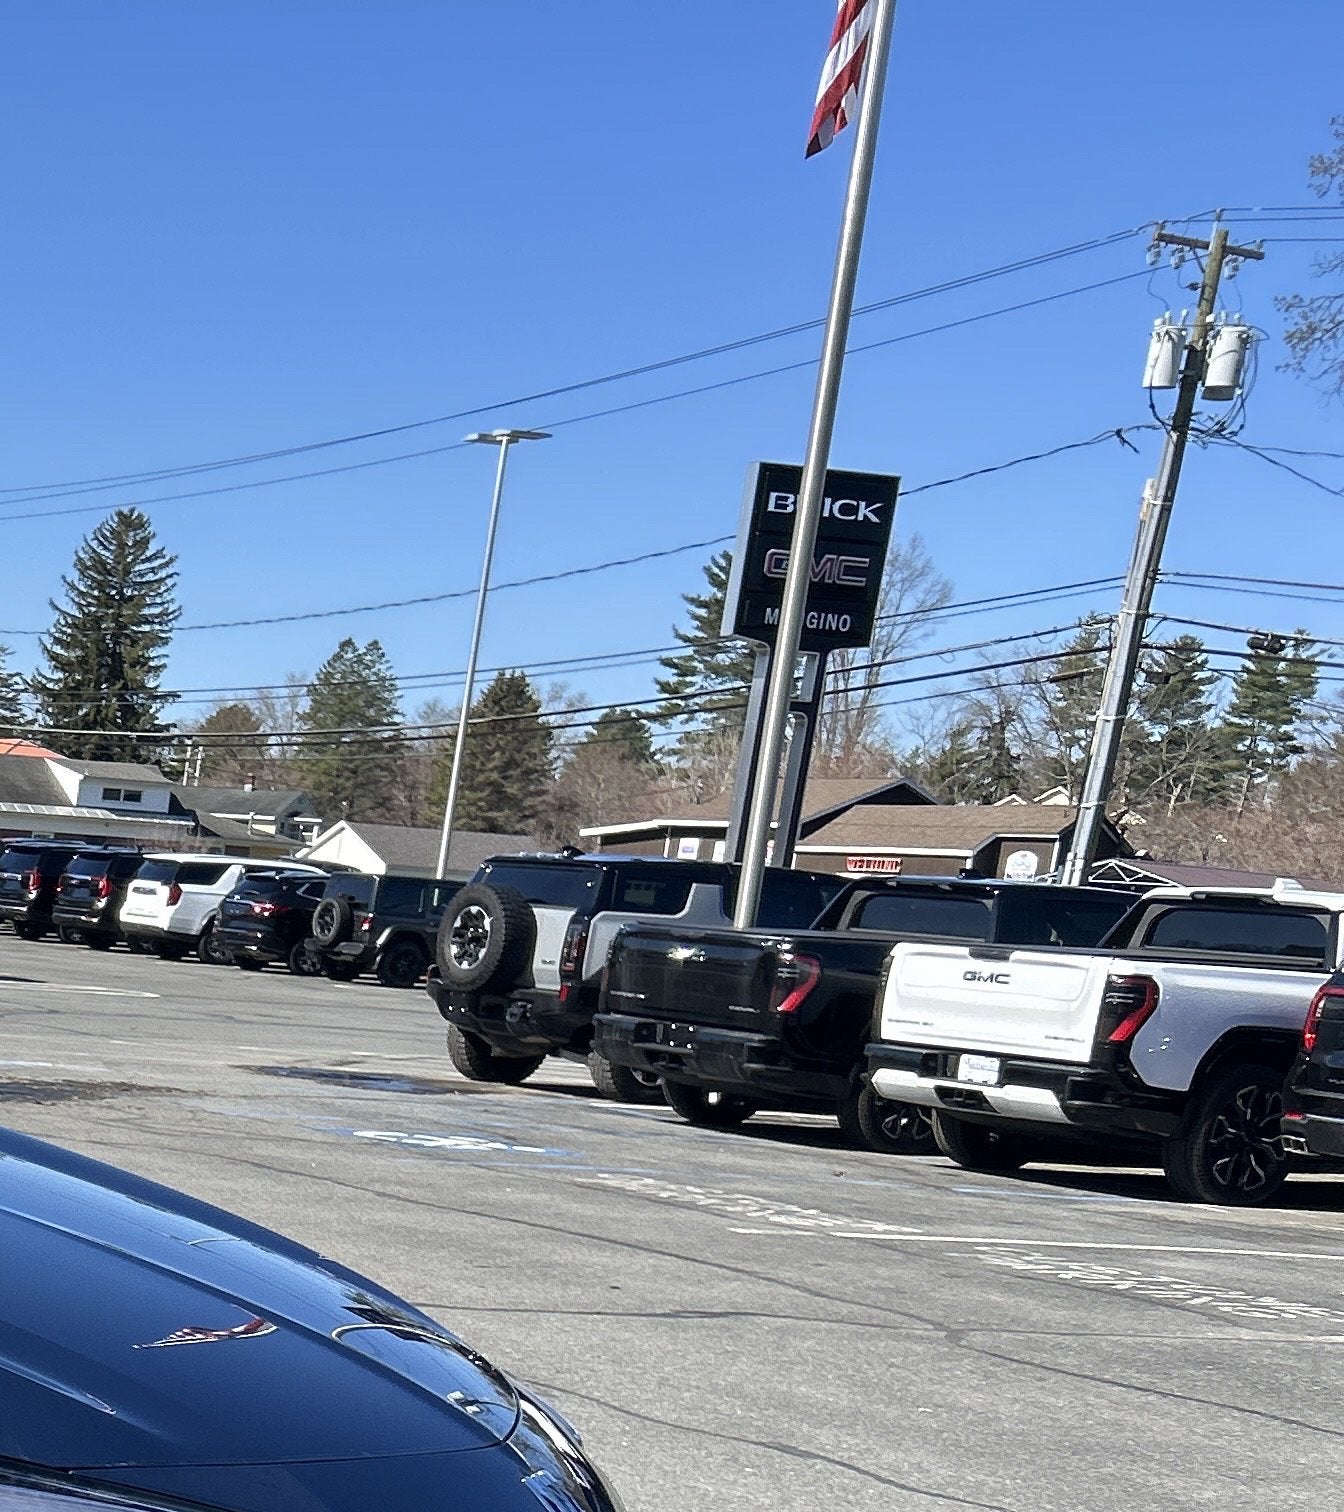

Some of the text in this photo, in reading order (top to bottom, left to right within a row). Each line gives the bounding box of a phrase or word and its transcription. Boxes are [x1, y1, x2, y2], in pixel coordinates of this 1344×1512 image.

[767, 491, 884, 523] BICK
[764, 607, 851, 632] MGINO
[962, 970, 1011, 985] GMC
